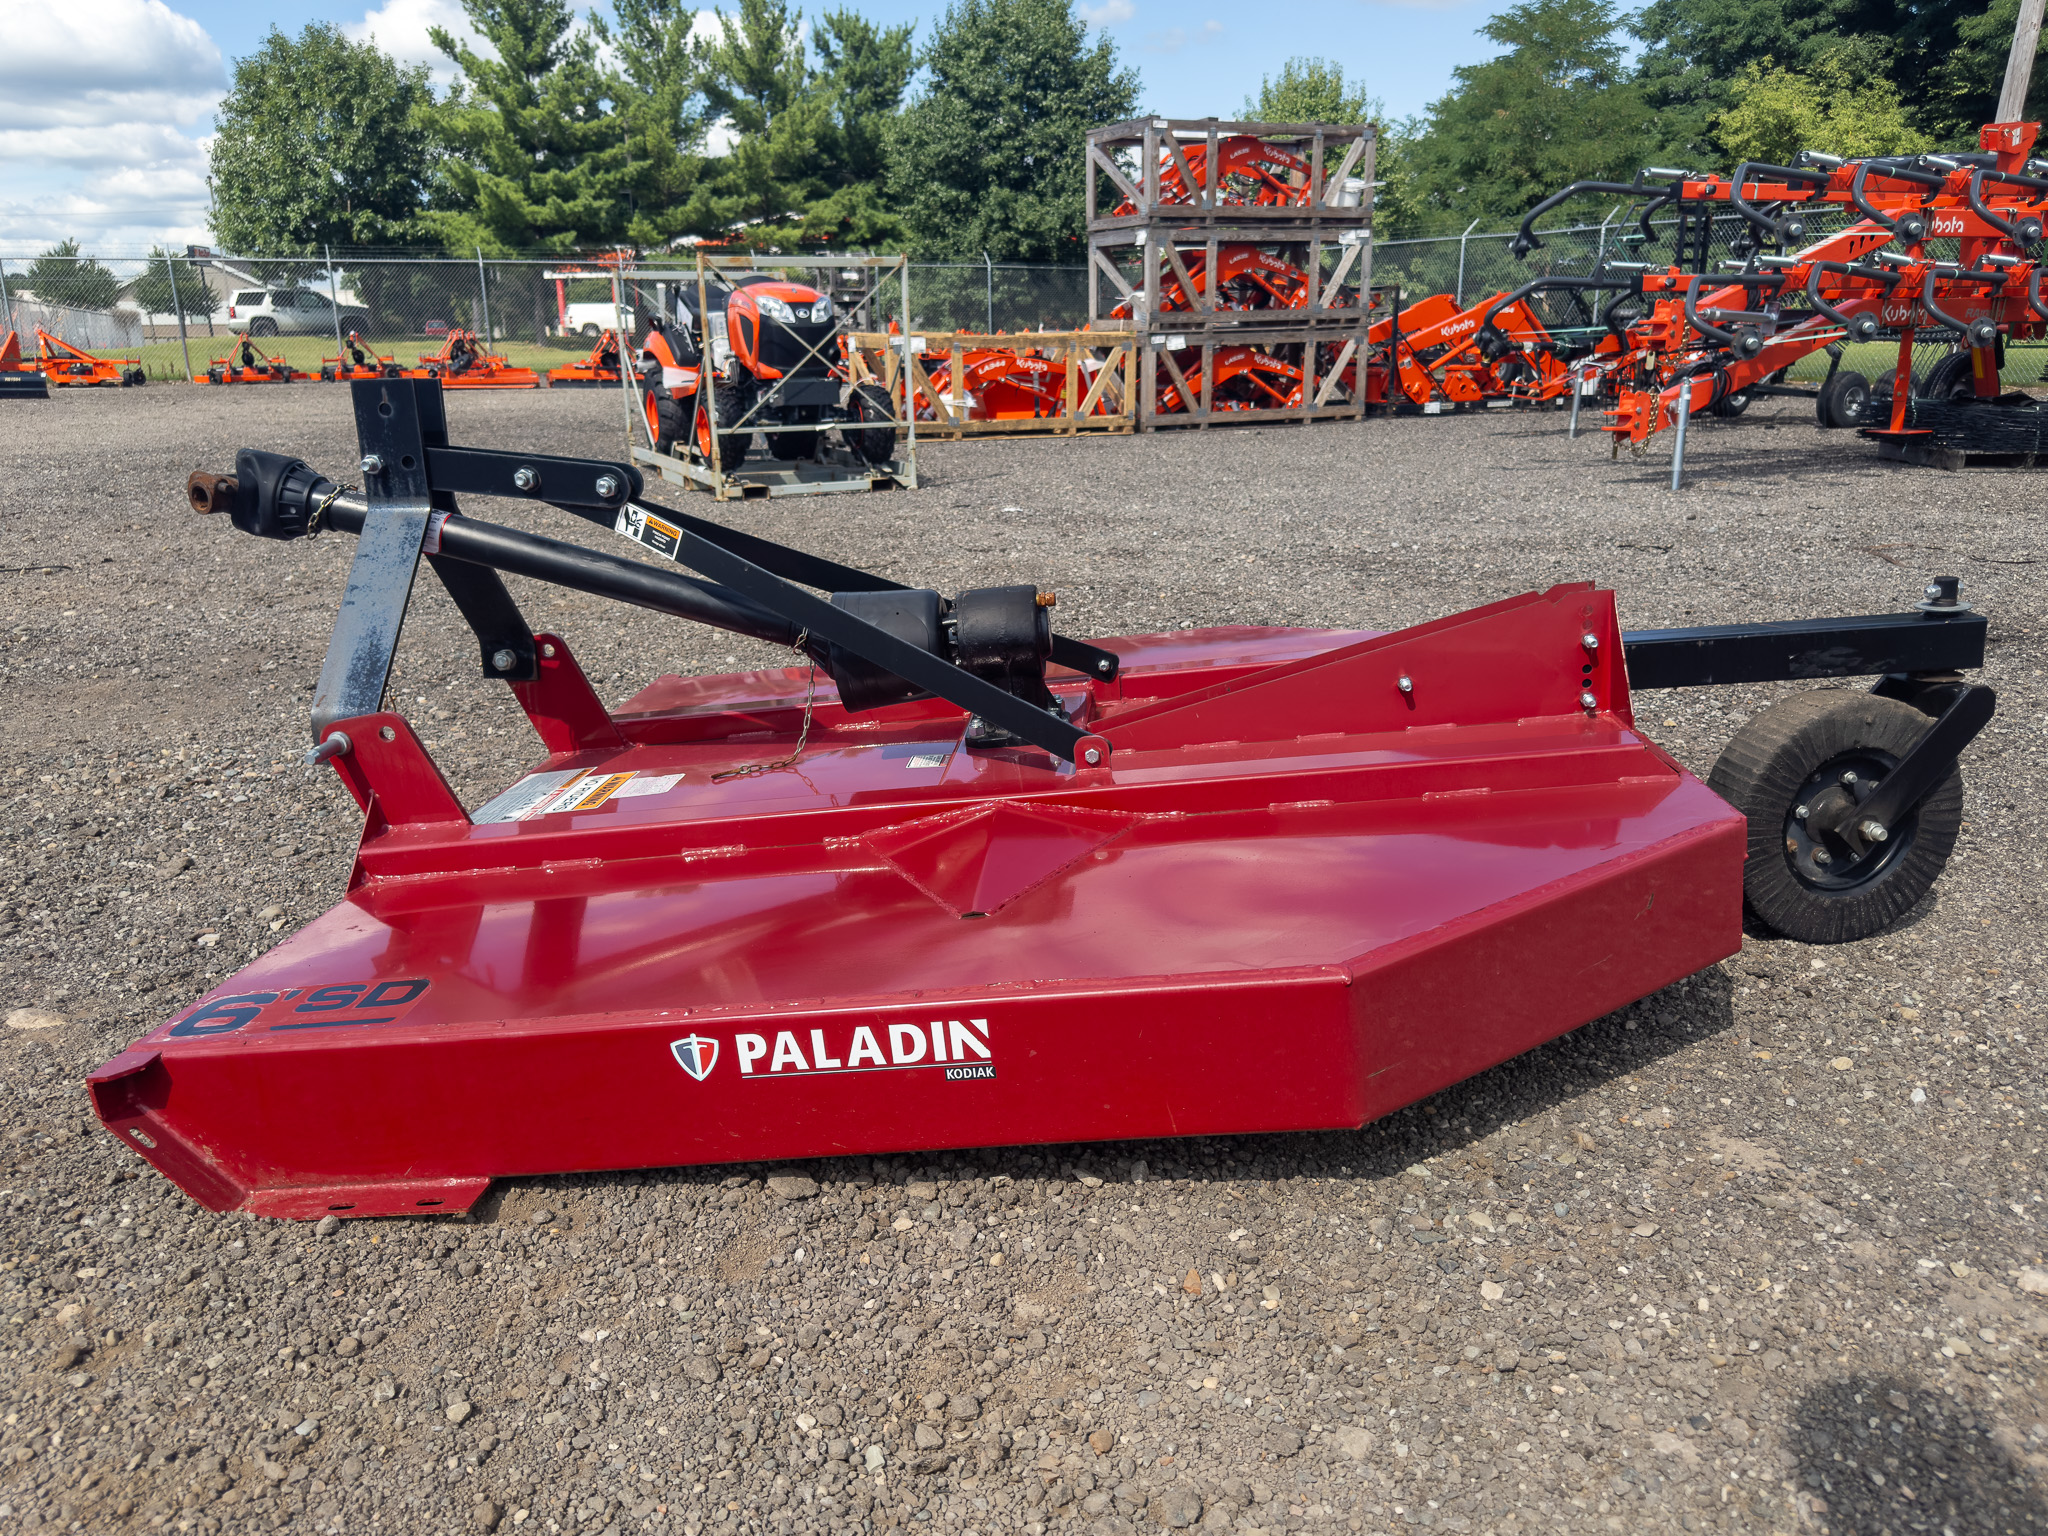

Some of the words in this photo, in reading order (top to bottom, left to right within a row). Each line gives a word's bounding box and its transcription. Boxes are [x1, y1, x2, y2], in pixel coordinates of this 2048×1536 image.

[1263, 145, 1290, 164] Kubota
[1259, 254, 1285, 270] Kubota
[1881, 304, 1928, 324] Kuboa
[1441, 319, 1475, 336] Kubota
[1016, 358, 1048, 371] Kubota
[1254, 353, 1282, 370] Kubota
[653, 521, 677, 537] WARNING
[553, 787, 591, 811] RIDERS
[735, 1019, 992, 1074] PALADIN
[946, 1066, 995, 1080] KODIAK
